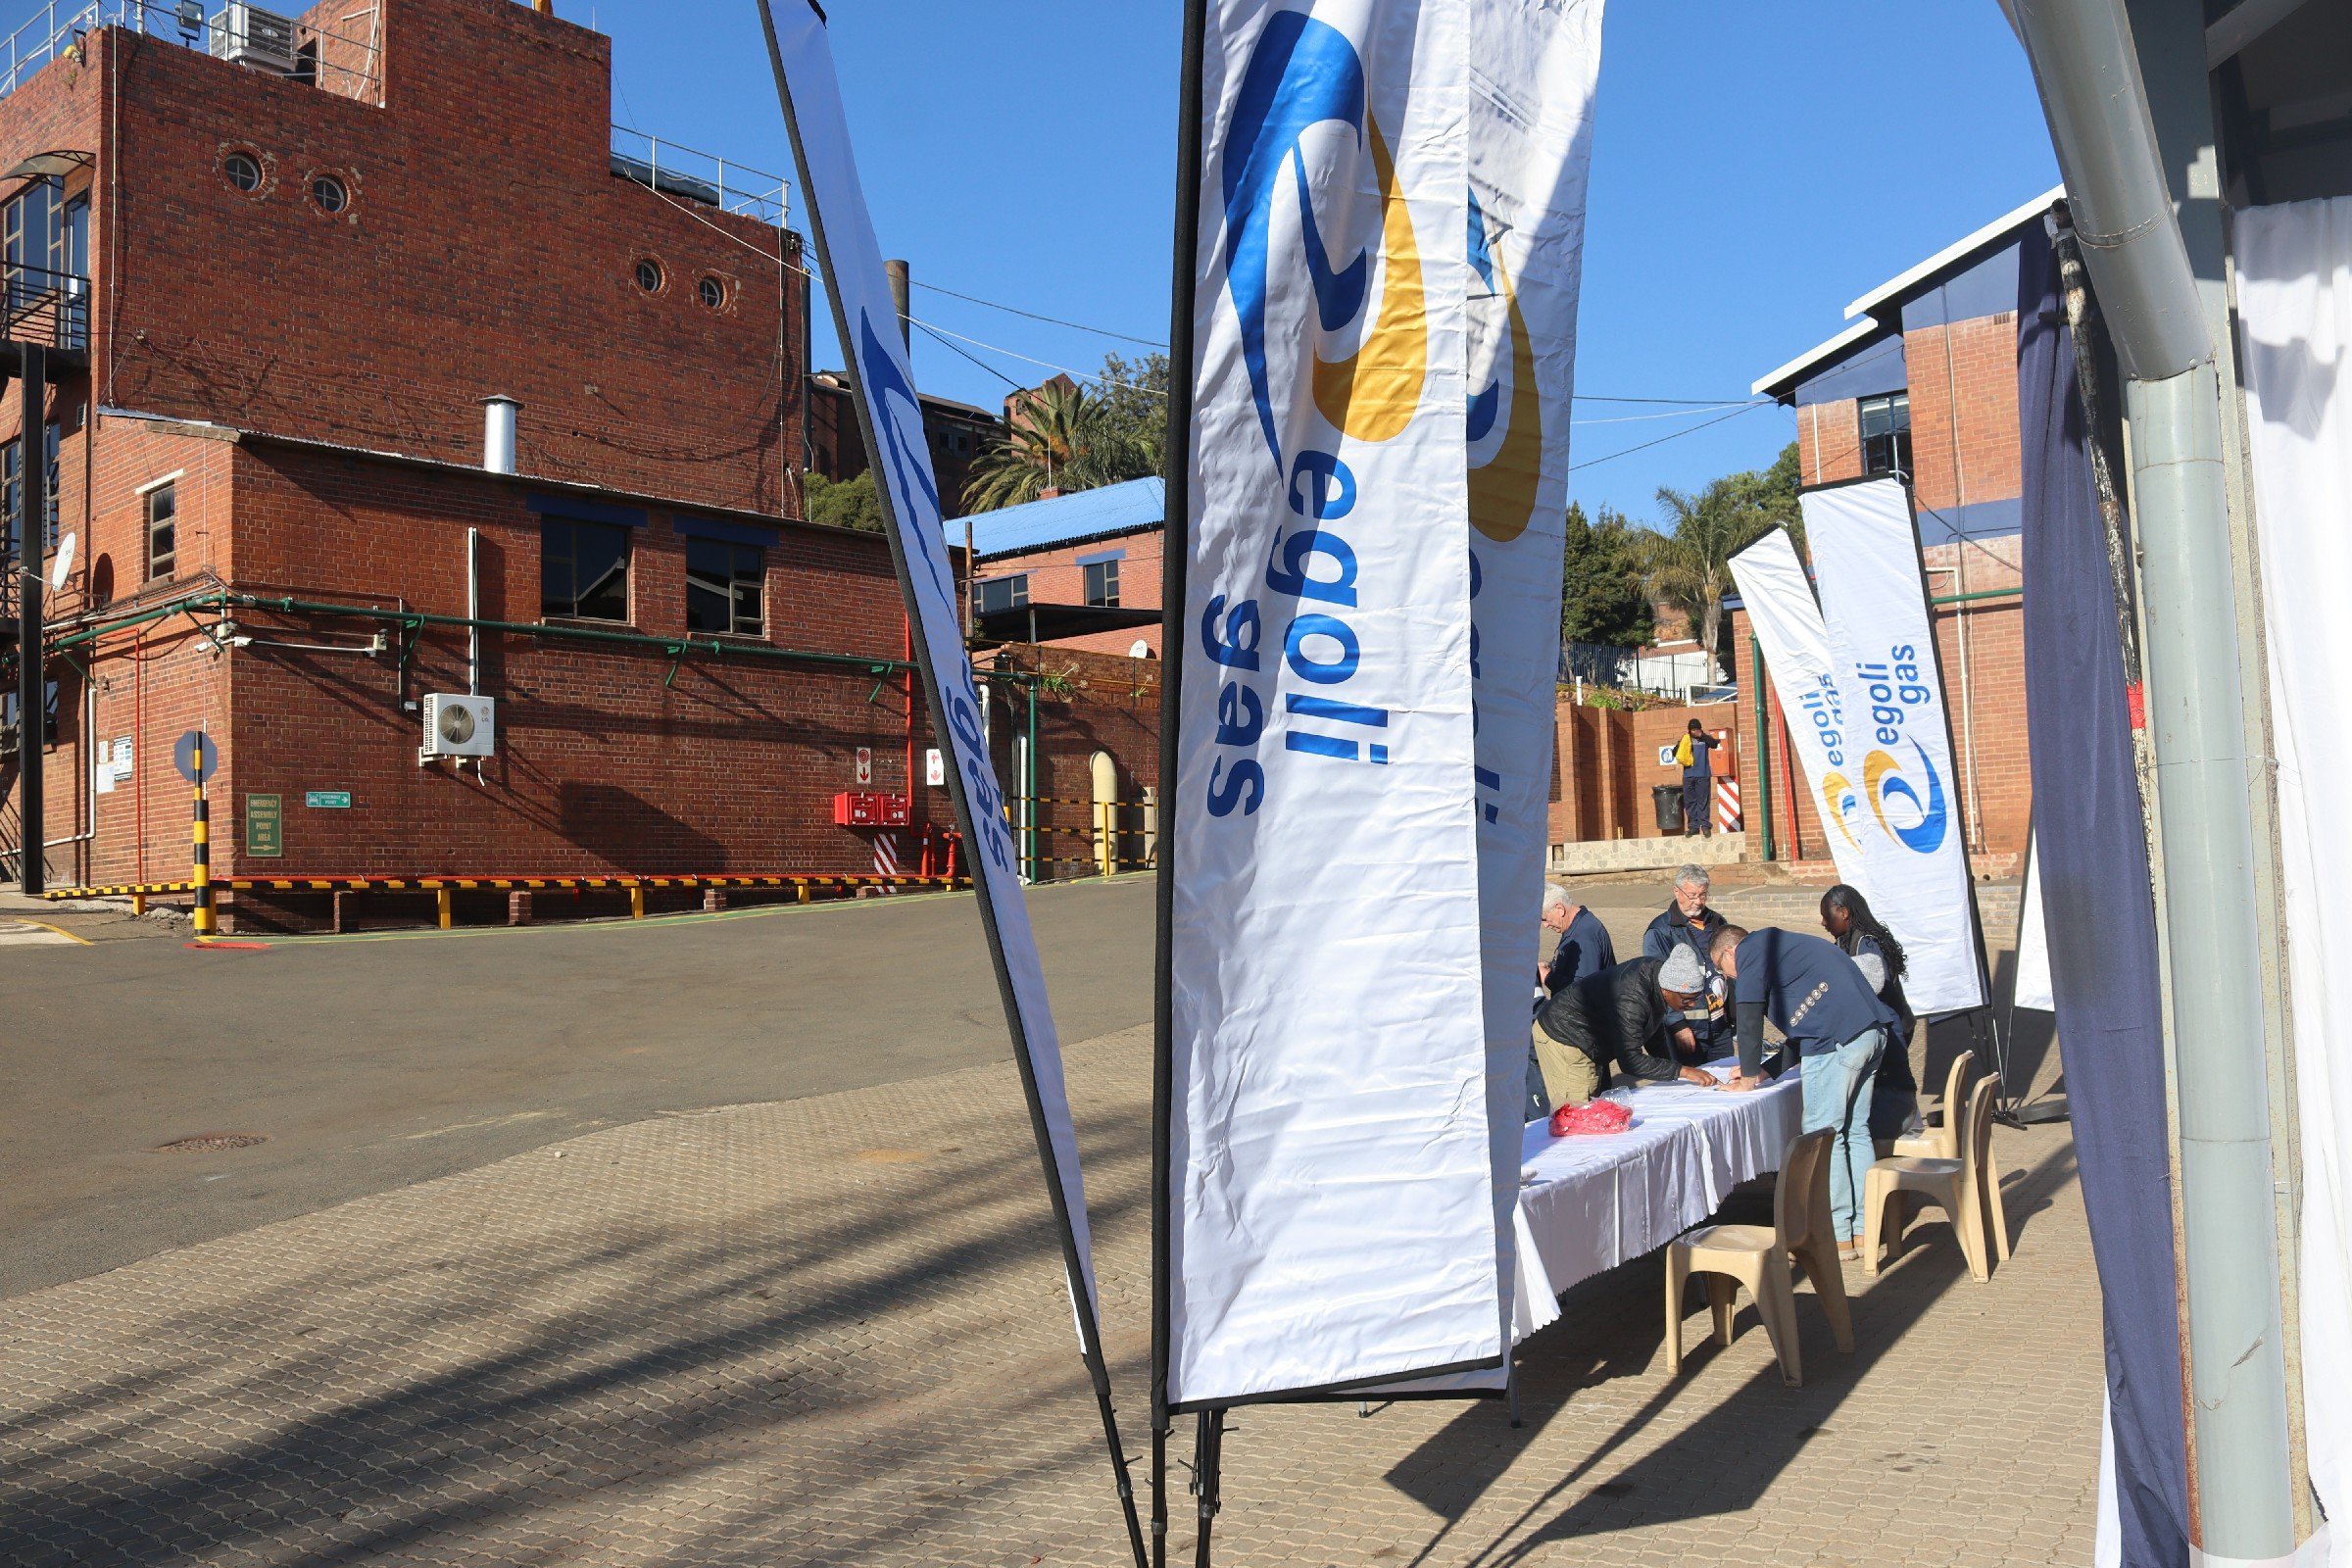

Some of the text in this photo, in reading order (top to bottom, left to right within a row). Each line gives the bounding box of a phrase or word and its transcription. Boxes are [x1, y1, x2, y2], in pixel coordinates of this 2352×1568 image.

[1266, 450, 1388, 764] egoli
[1201, 595, 1264, 817] gas
[1856, 662, 1904, 745] egoli
[1891, 645, 1931, 704] gas
[1798, 692, 1843, 766] egoli
